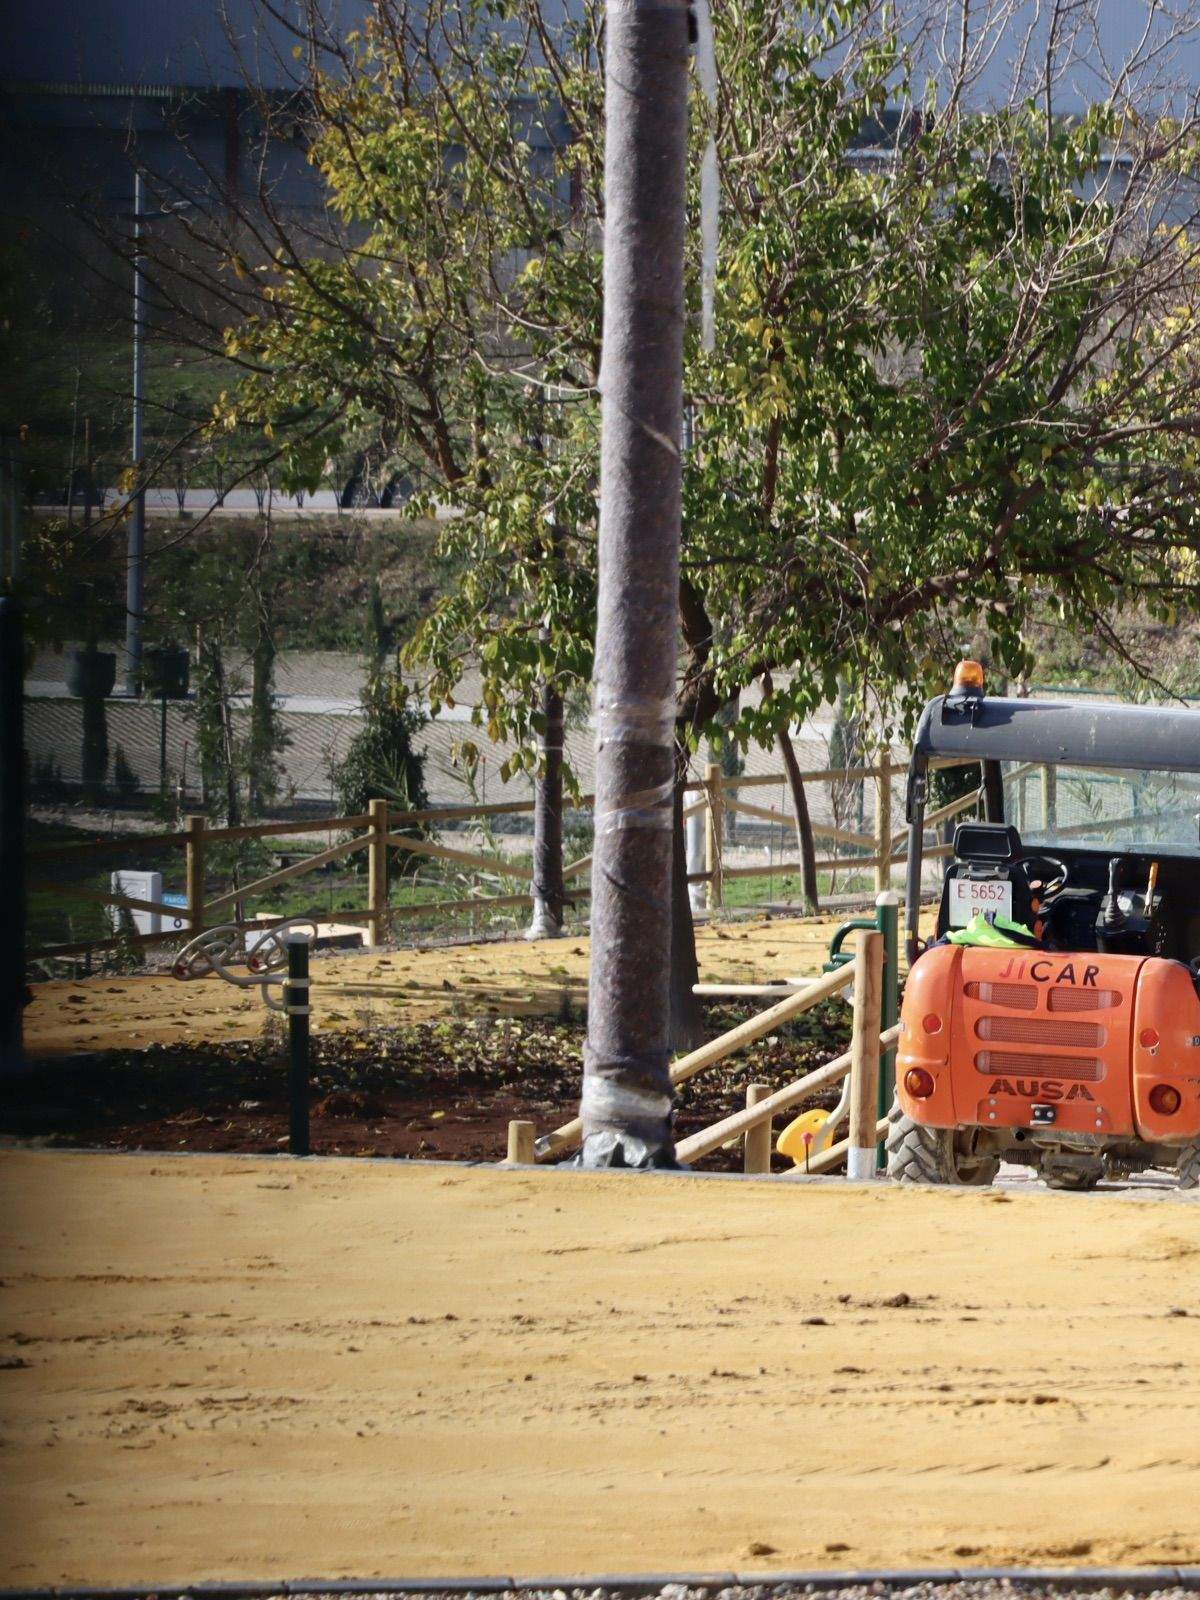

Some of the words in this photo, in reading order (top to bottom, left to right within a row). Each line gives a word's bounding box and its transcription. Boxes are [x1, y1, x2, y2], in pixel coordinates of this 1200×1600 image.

[957, 883, 967, 899] E
[971, 884, 1006, 901] 5652
[998, 957, 1100, 987] JICAR
[988, 1078, 1095, 1101] AUSA
